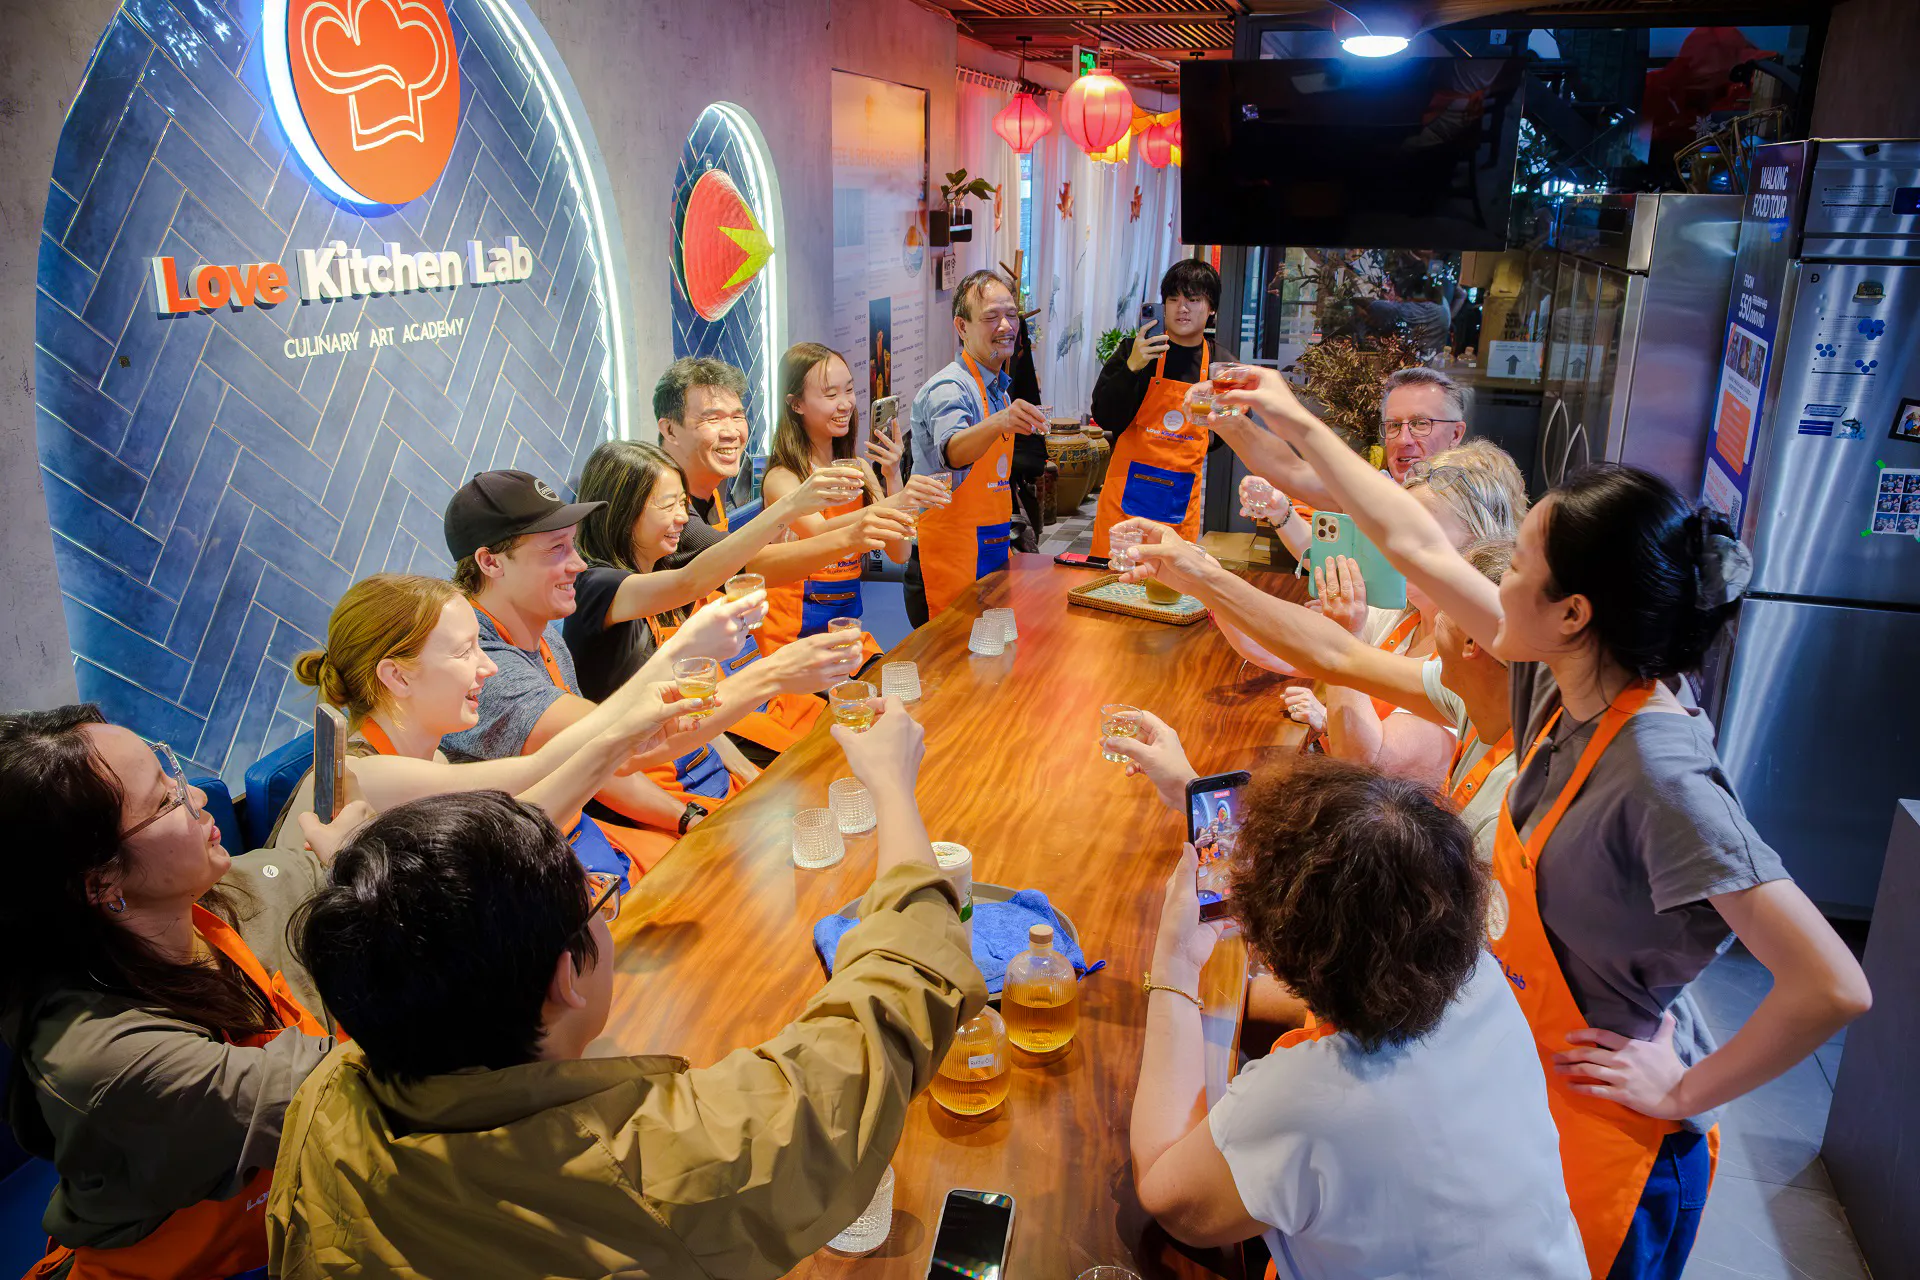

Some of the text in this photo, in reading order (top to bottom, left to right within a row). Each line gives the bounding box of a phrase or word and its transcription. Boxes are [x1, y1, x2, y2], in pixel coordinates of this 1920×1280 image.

[1760, 165, 1789, 191] WALKING
[1752, 193, 1788, 219] FOOD TOUR
[155, 236, 533, 313] Love Kitchen Lab
[283, 317, 465, 360] CULINARY ART ACADEMY
[1505, 964, 1526, 991] Lab
